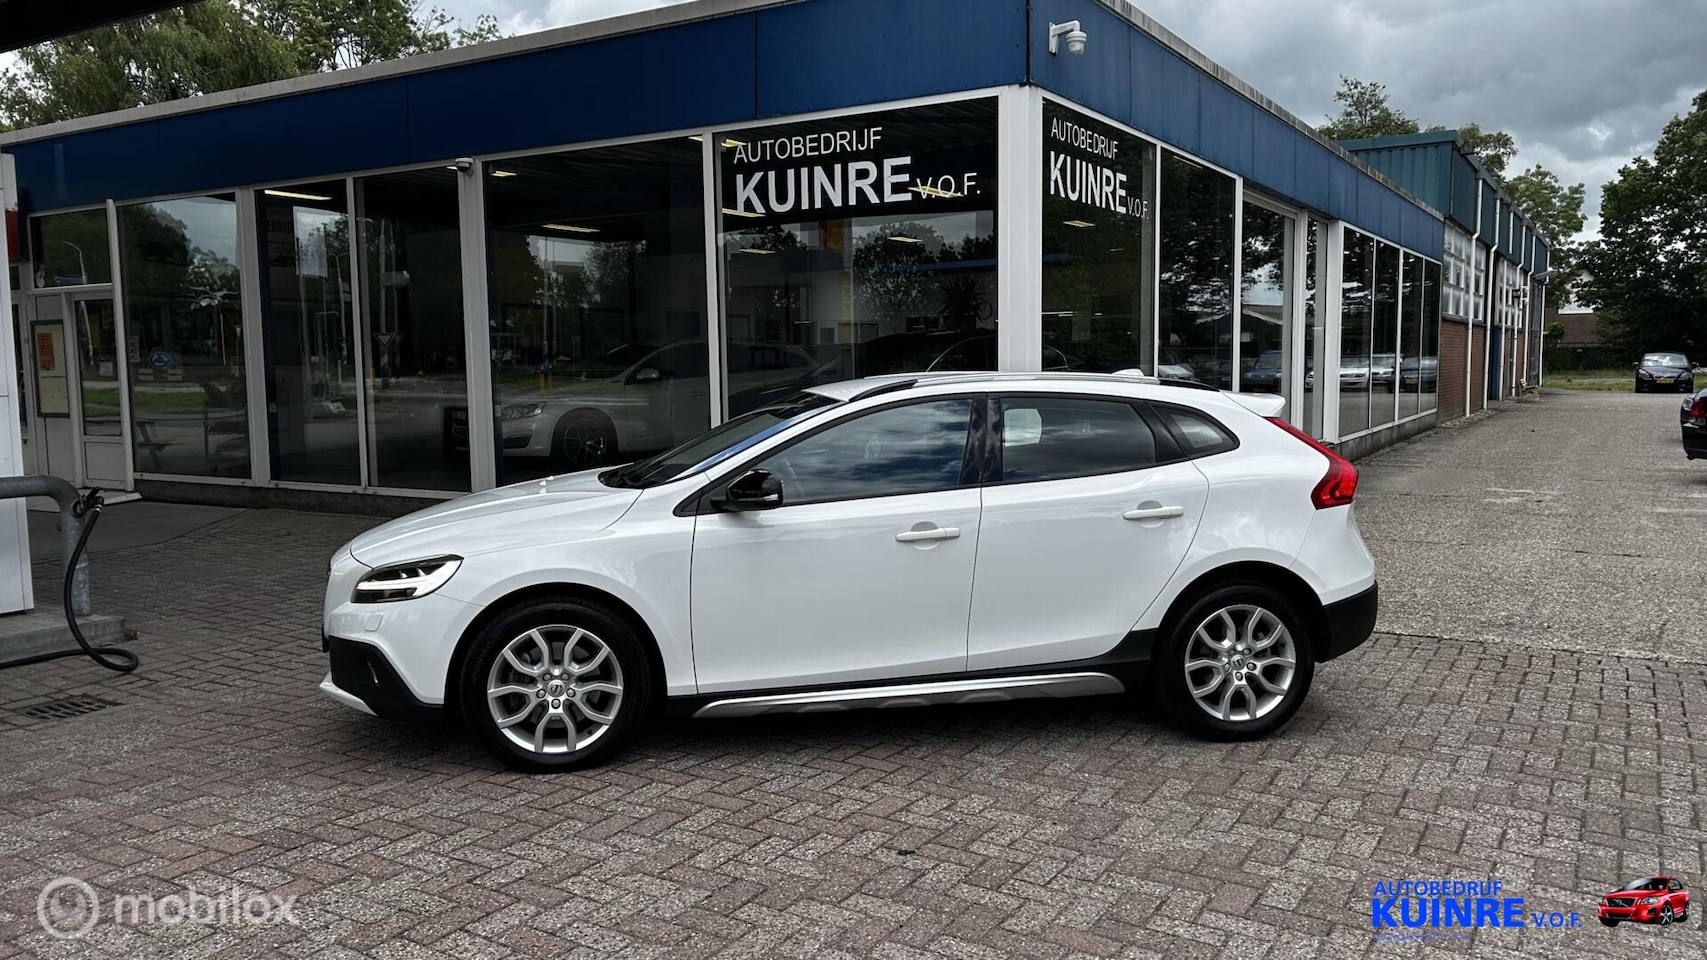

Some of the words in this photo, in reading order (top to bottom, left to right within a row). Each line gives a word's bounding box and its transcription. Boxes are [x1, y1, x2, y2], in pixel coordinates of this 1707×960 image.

[734, 127, 882, 164] AUTOBEDRIJF
[1050, 117, 1118, 159] AUTOBEDRIJF
[736, 156, 912, 214] KUINRE
[916, 172, 981, 200] V.O.F.
[1050, 150, 1127, 214] KUINRE
[1127, 196, 1149, 219] V.O.F.
